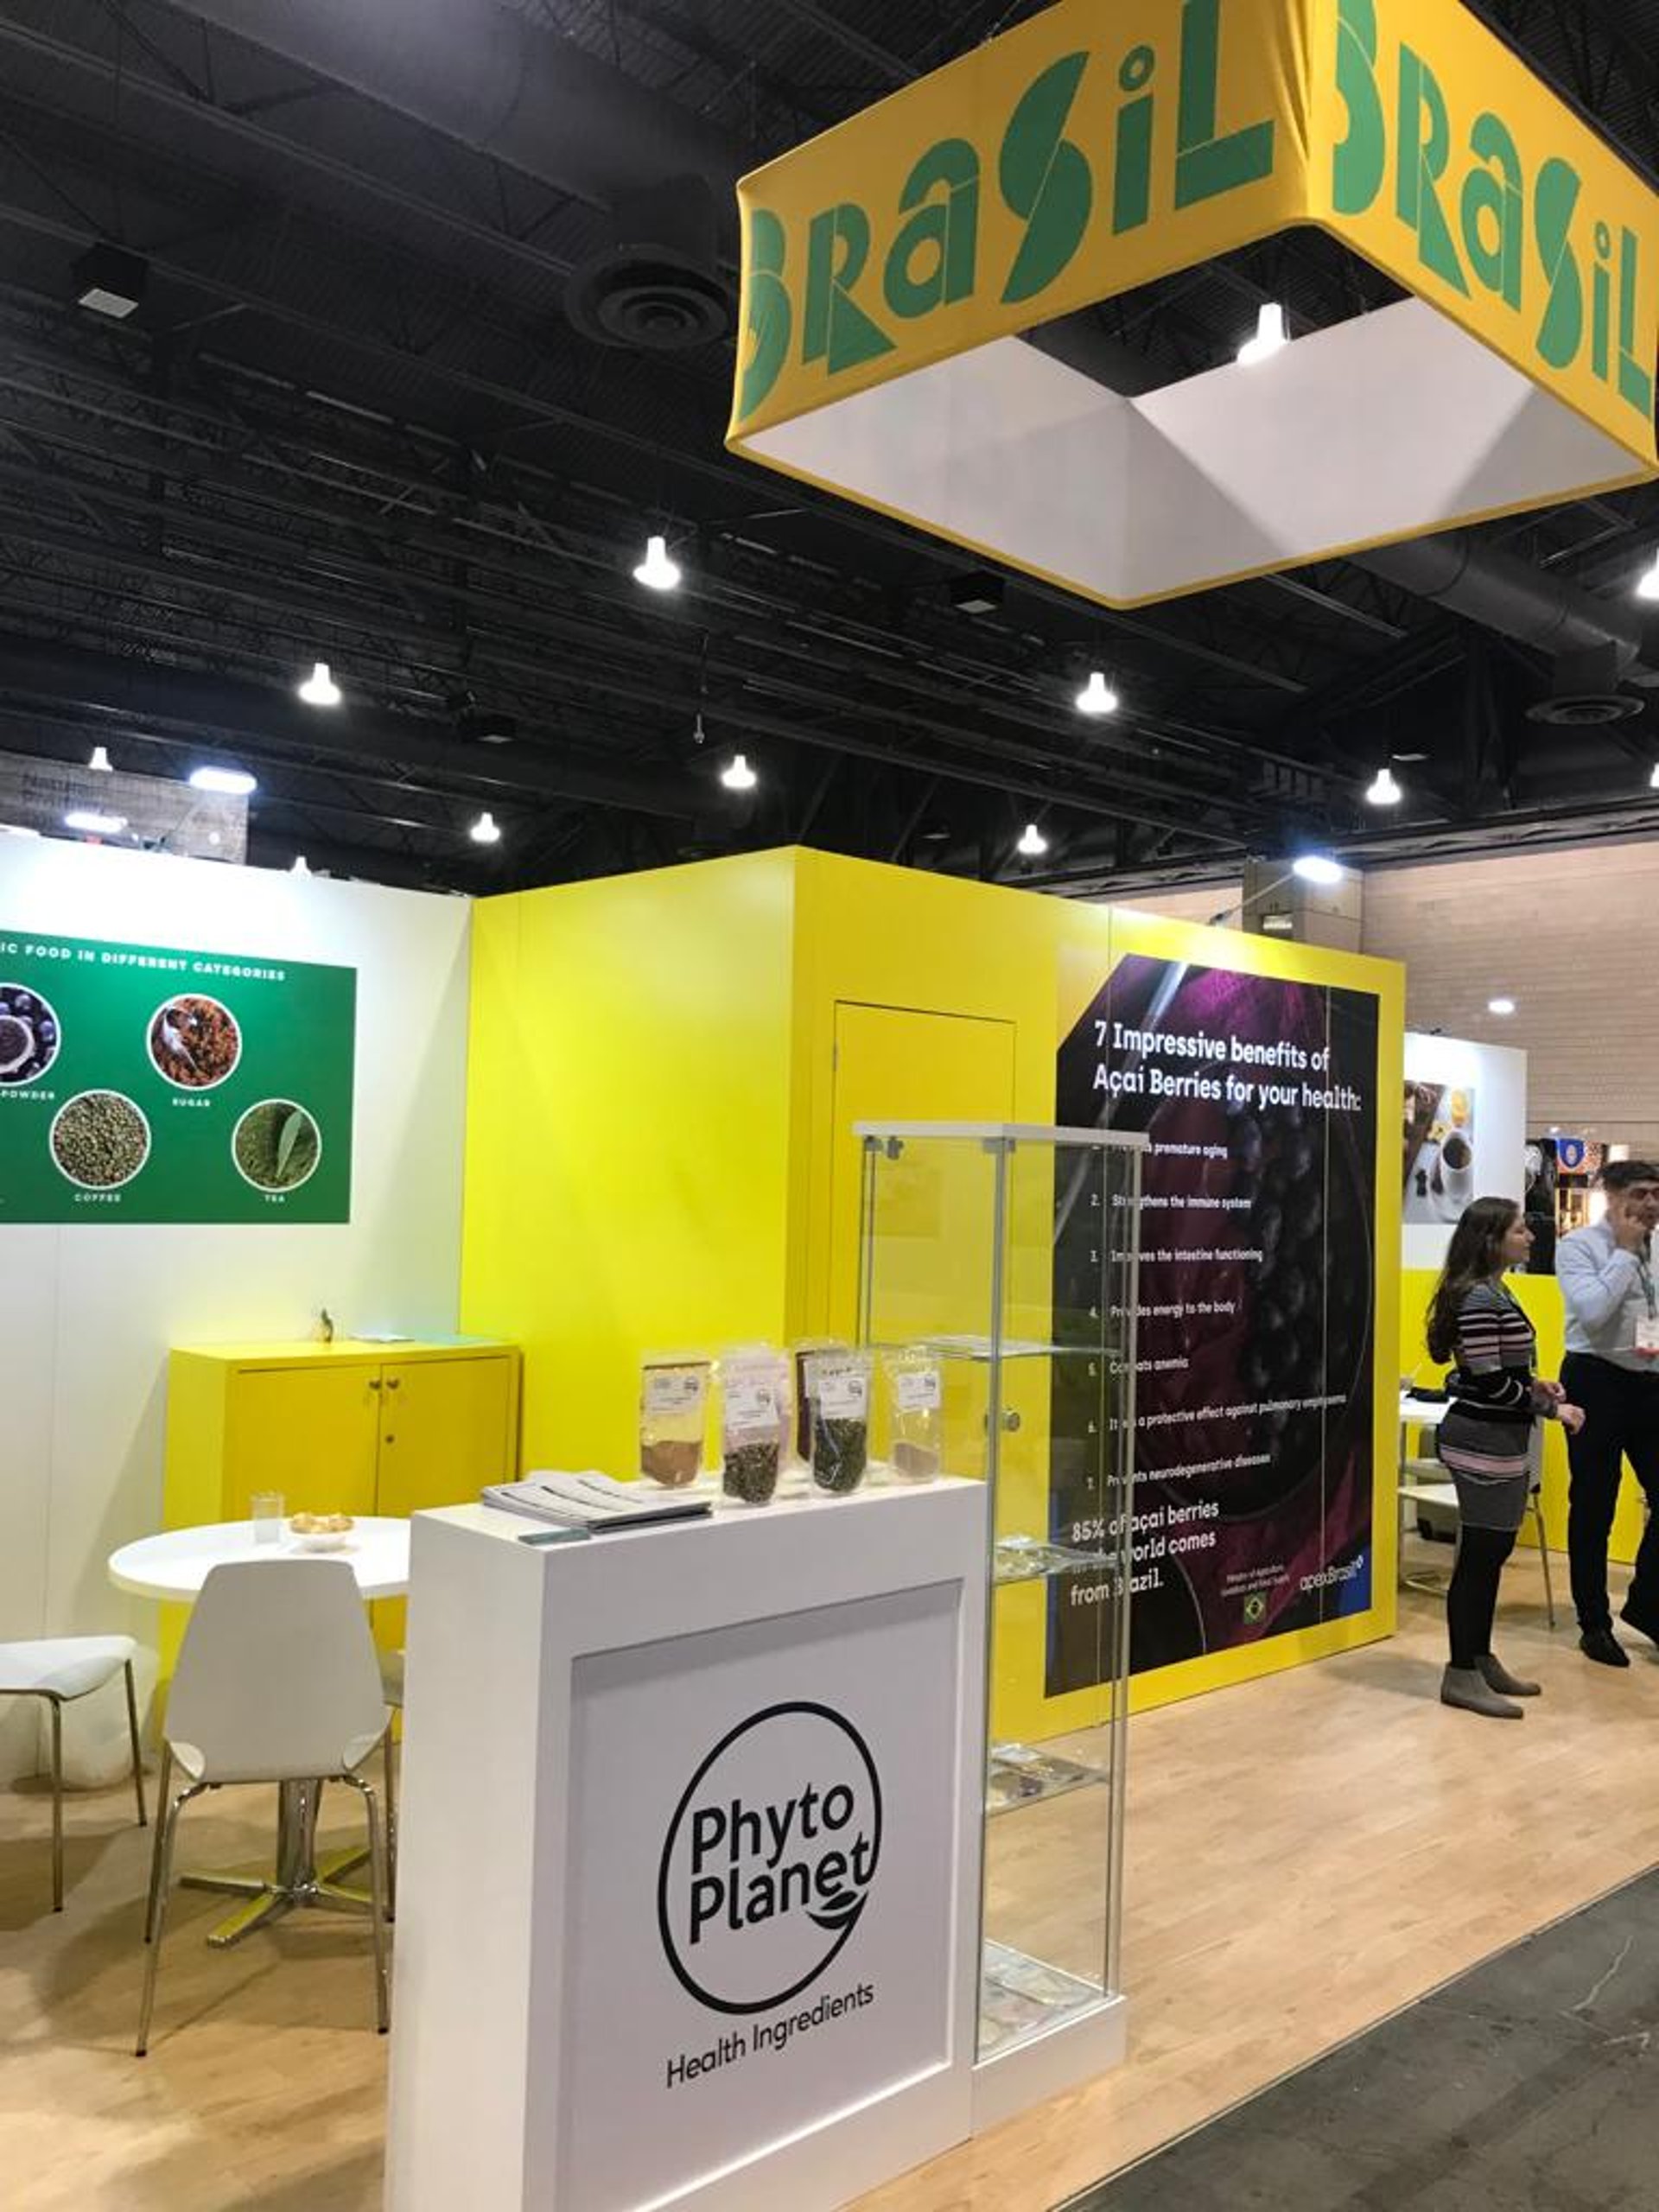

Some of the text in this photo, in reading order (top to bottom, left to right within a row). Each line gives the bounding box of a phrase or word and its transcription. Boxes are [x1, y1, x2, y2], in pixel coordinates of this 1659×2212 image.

[25, 944, 72, 960] FOOD
[78, 950, 96, 963] IN
[101, 953, 188, 972] DIFFERENT
[193, 961, 287, 982] CATEGORIES
[1094, 1020, 1331, 1072] 7 Impressive benefits of
[1, 1090, 55, 1100] POWDER
[1093, 1064, 1362, 1111] Açai Berries for your health:
[172, 1096, 212, 1108] SUGAR
[1154, 1142, 1202, 1157] premature
[1203, 1144, 1228, 1159] aging
[73, 1192, 122, 1203] COFFEE
[264, 1194, 286, 1203] TEA
[1170, 1195, 1185, 1207] the
[1187, 1196, 1220, 1209] immune
[1221, 1198, 1252, 1211] system
[1157, 1249, 1173, 1262] the
[1174, 1249, 1213, 1262] intestine
[1215, 1249, 1263, 1262] functioning
[1153, 1304, 1183, 1319] energy
[1185, 1303, 1196, 1316] to
[1198, 1303, 1212, 1315] the
[1214, 1300, 1236, 1316] body
[1154, 1358, 1189, 1371] anemia
[1147, 1409, 1194, 1430] protective
[1196, 1406, 1224, 1421] effect
[1225, 1402, 1257, 1421] against
[1071, 1518, 1105, 1543] 85%
[1132, 1504, 1166, 1535] açai
[1168, 1498, 1220, 1525] berries
[1168, 1529, 1217, 1555] comes
[1071, 1583, 1109, 1607] from
[691, 1783, 855, 1875] Phyto
[690, 1831, 871, 1945] Planet
[666, 1983, 874, 2089] Health Ingredients
